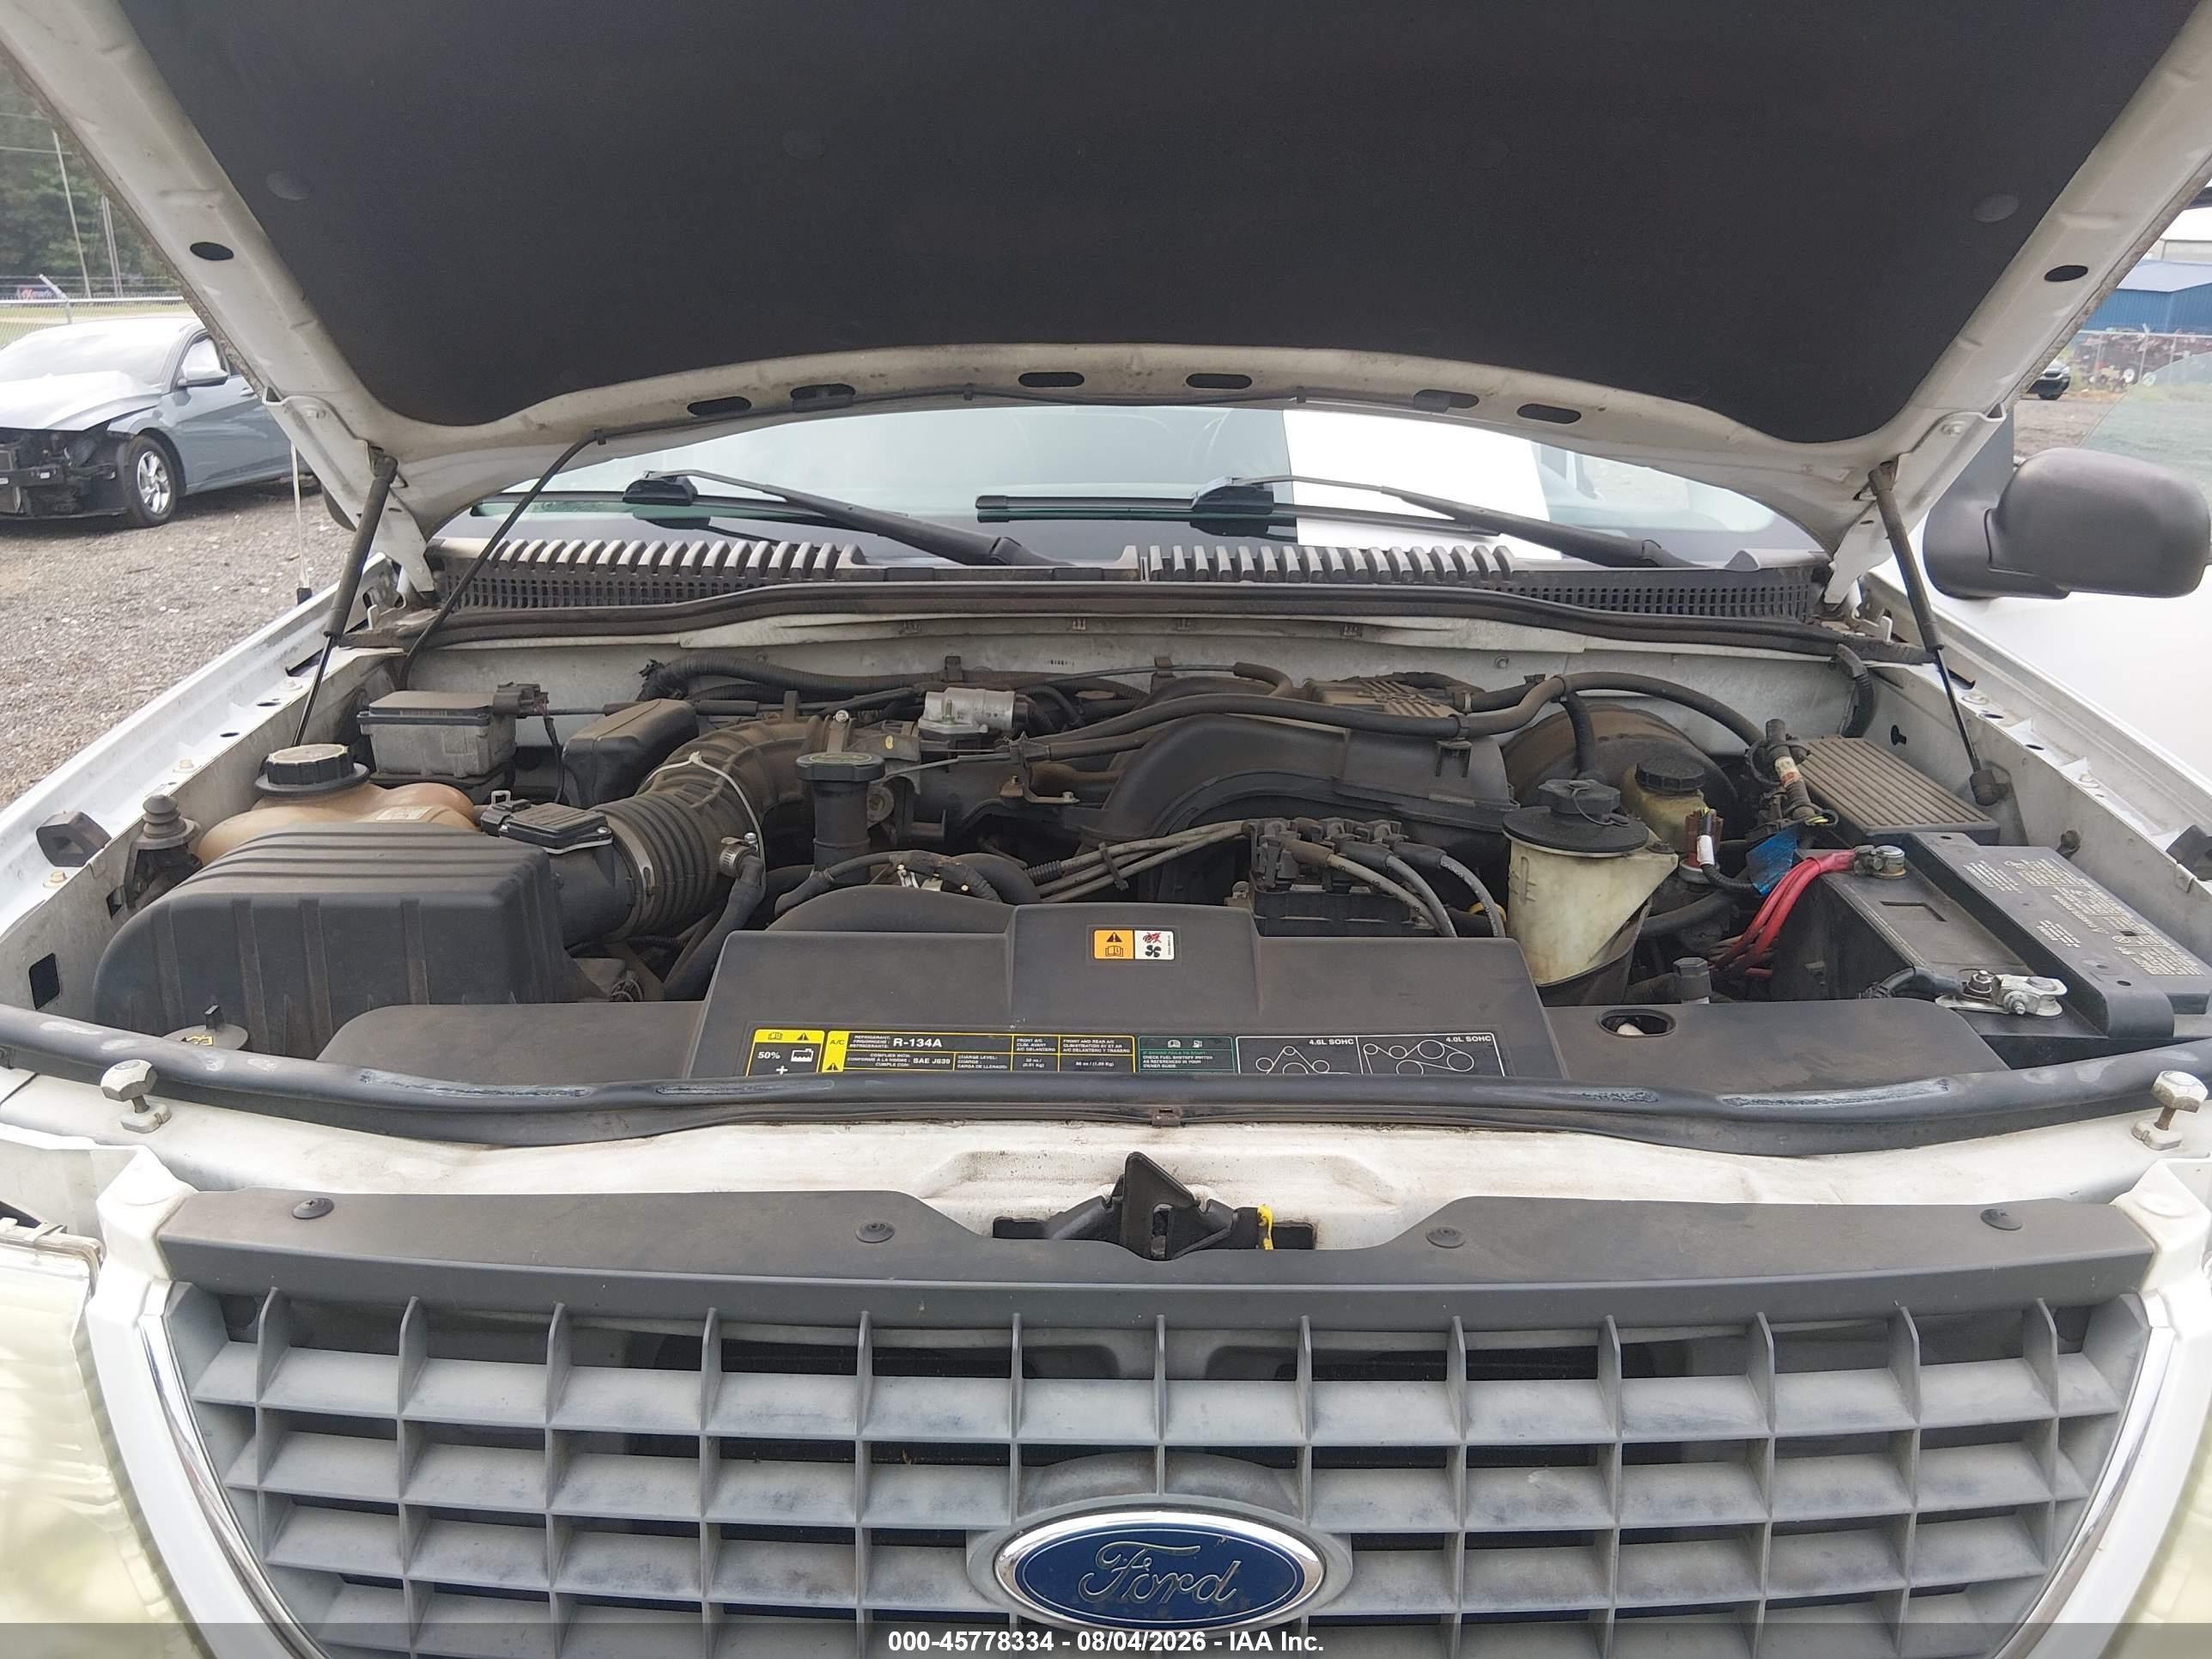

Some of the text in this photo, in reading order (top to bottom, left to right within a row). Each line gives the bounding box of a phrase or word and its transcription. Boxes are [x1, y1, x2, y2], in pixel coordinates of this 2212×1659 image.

[893, 1037, 943, 1048] R-134A
[757, 1051, 781, 1060] 50%
[1079, 1540, 1242, 1603] Ford
